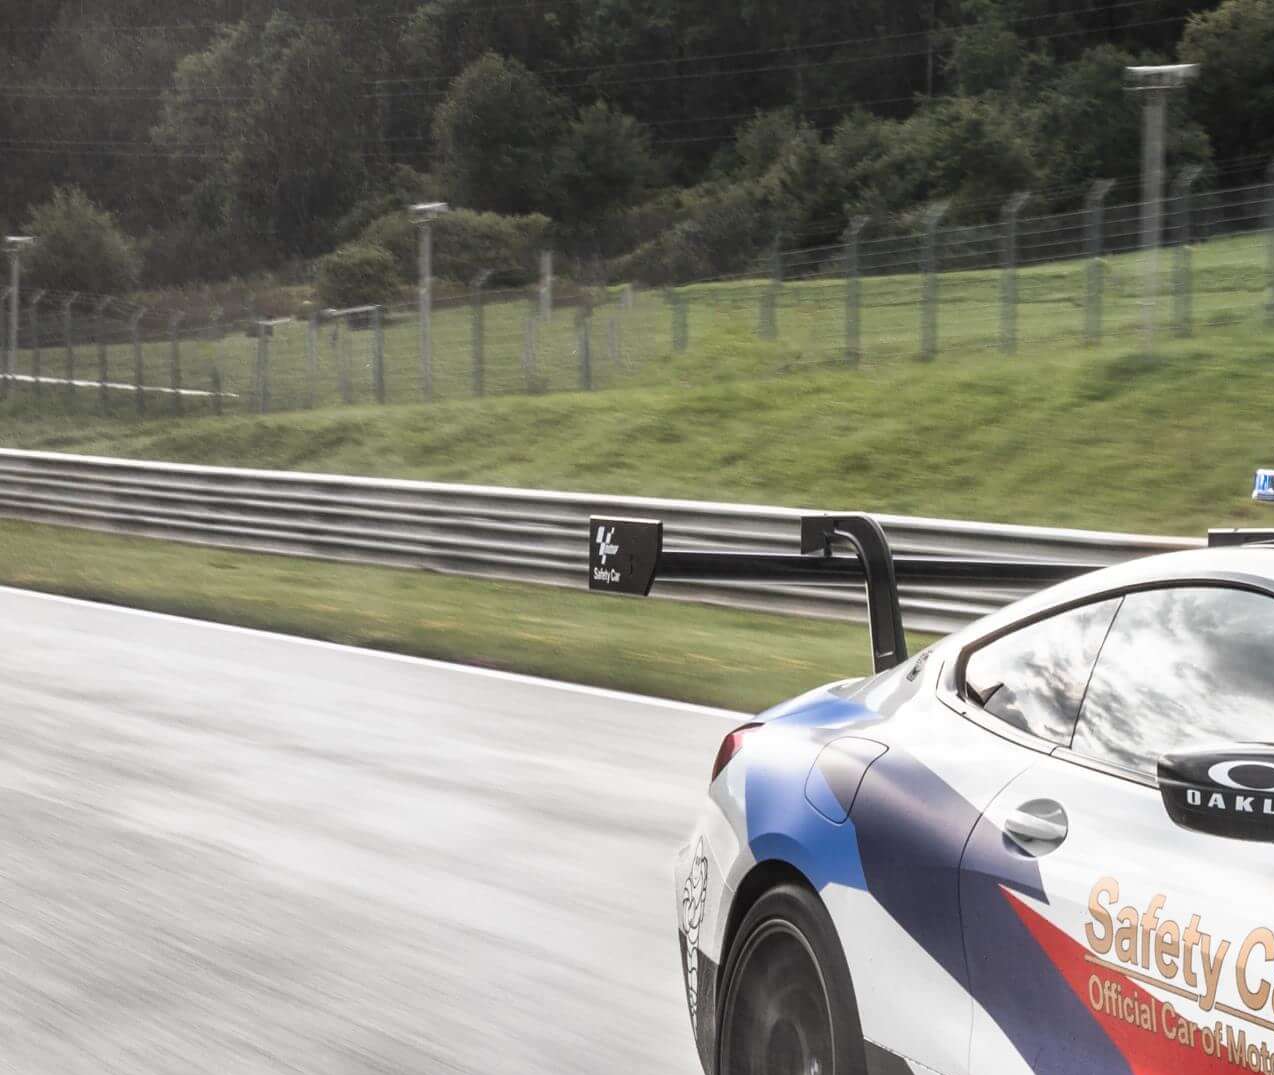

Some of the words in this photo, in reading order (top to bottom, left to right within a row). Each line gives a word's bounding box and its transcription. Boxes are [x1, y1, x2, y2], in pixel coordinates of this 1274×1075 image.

[1085, 876, 1231, 1011] Safety
[1088, 975, 1158, 1033] Official
[1161, 1003, 1198, 1047] Car
[1201, 1022, 1223, 1056] of
